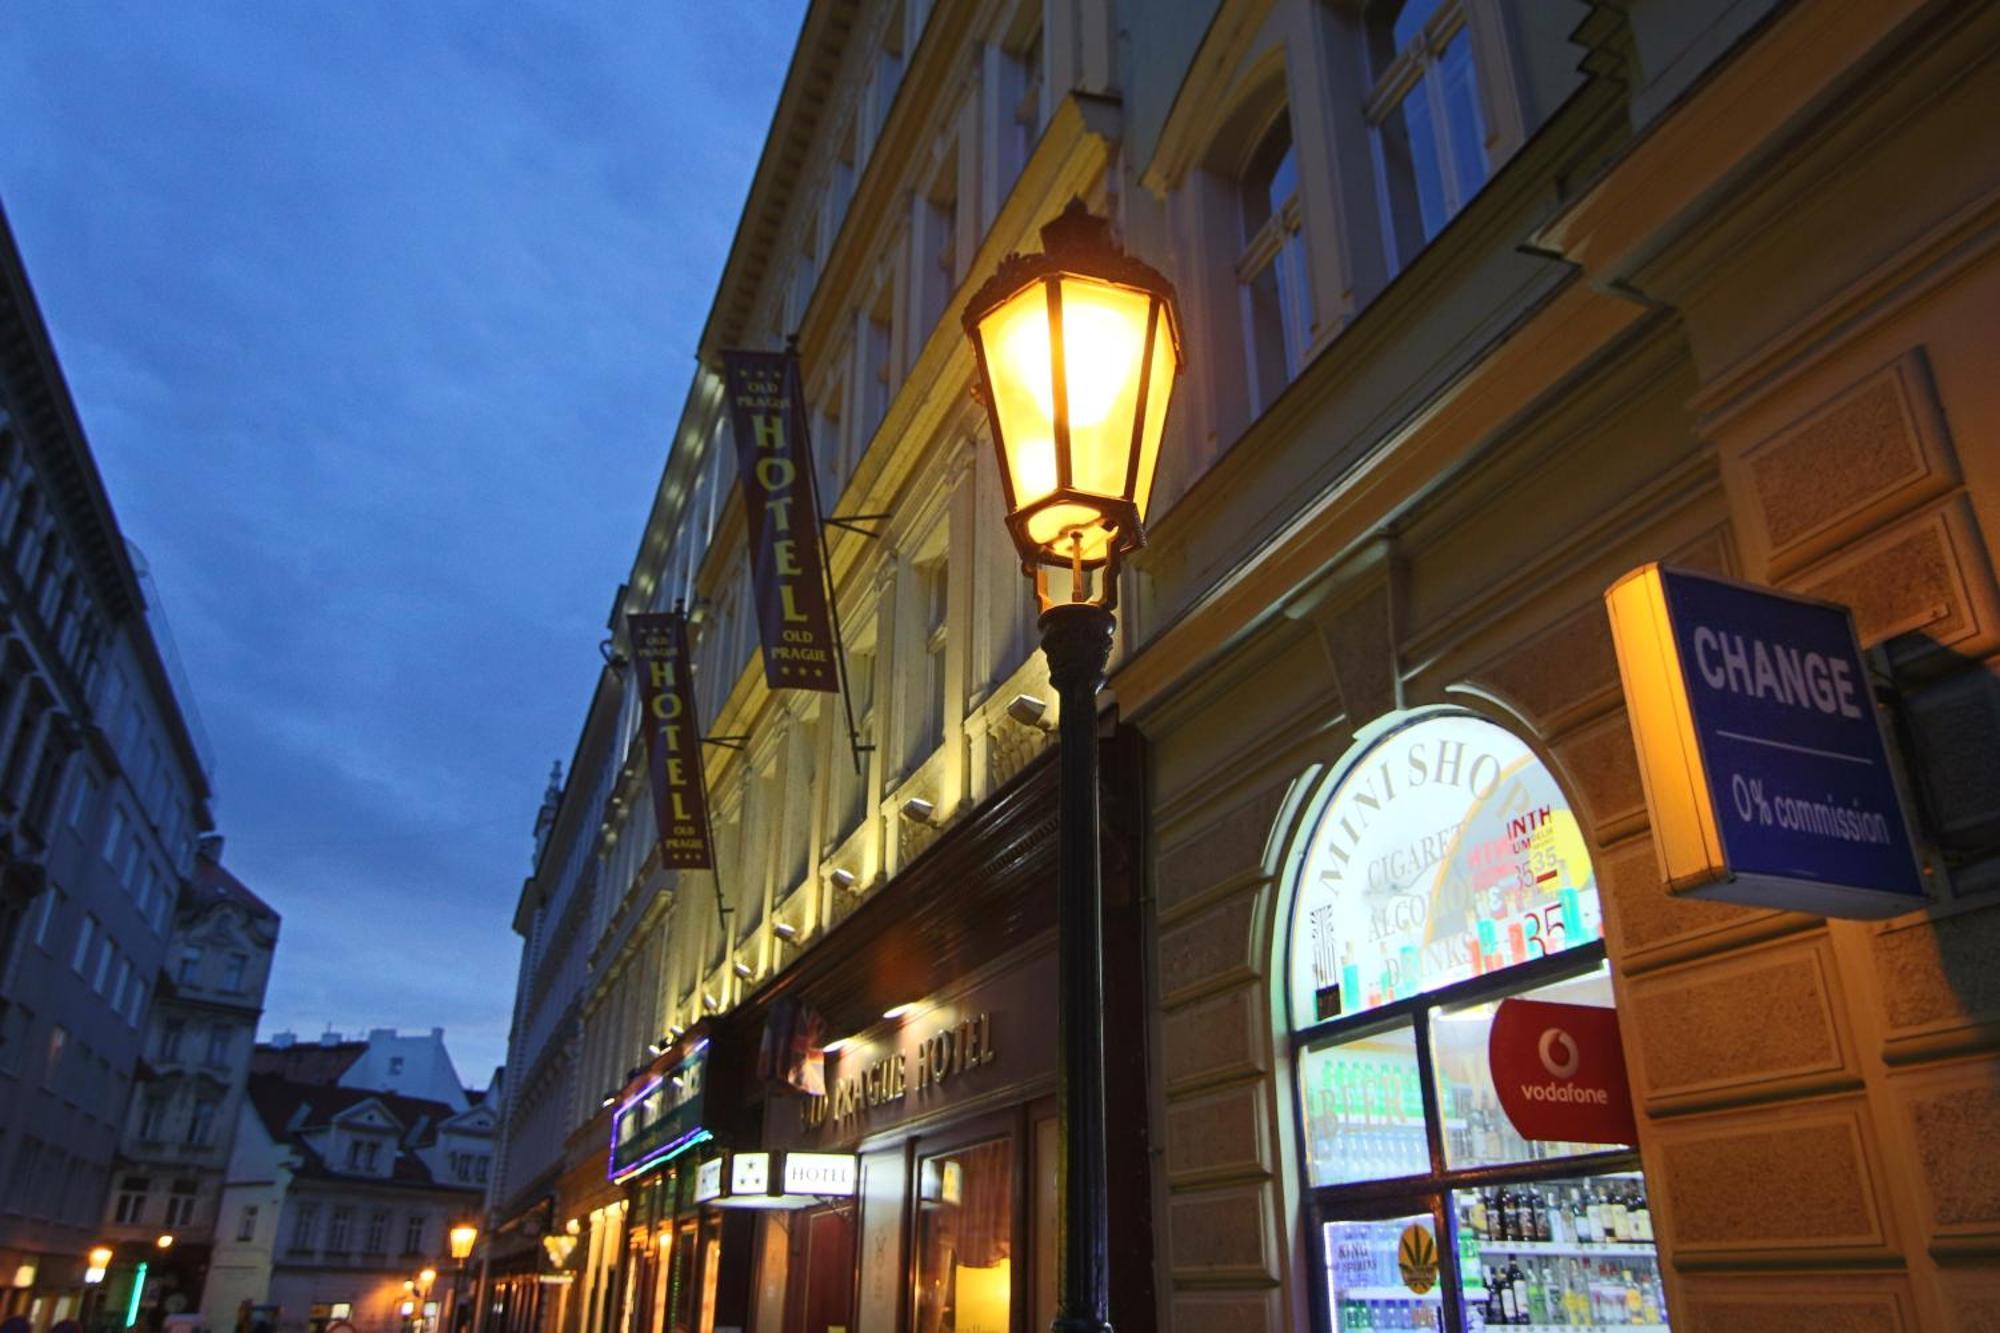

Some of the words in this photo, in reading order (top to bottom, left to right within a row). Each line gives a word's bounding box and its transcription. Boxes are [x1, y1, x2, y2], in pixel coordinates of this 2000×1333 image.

[752, 415, 808, 622] HOTEL
[770, 646, 828, 663] PRAGUE
[782, 629, 813, 643] OLD
[1694, 626, 1863, 720] CHANGE
[651, 660, 691, 821] HOTEL
[1318, 760, 1397, 898] MINI
[1732, 773, 1773, 826] 0%
[1775, 793, 1891, 845] commission
[915, 1012, 996, 1091] HOTEL
[1521, 1083, 1608, 1105] vodafone
[791, 1166, 848, 1184] HOTEL
